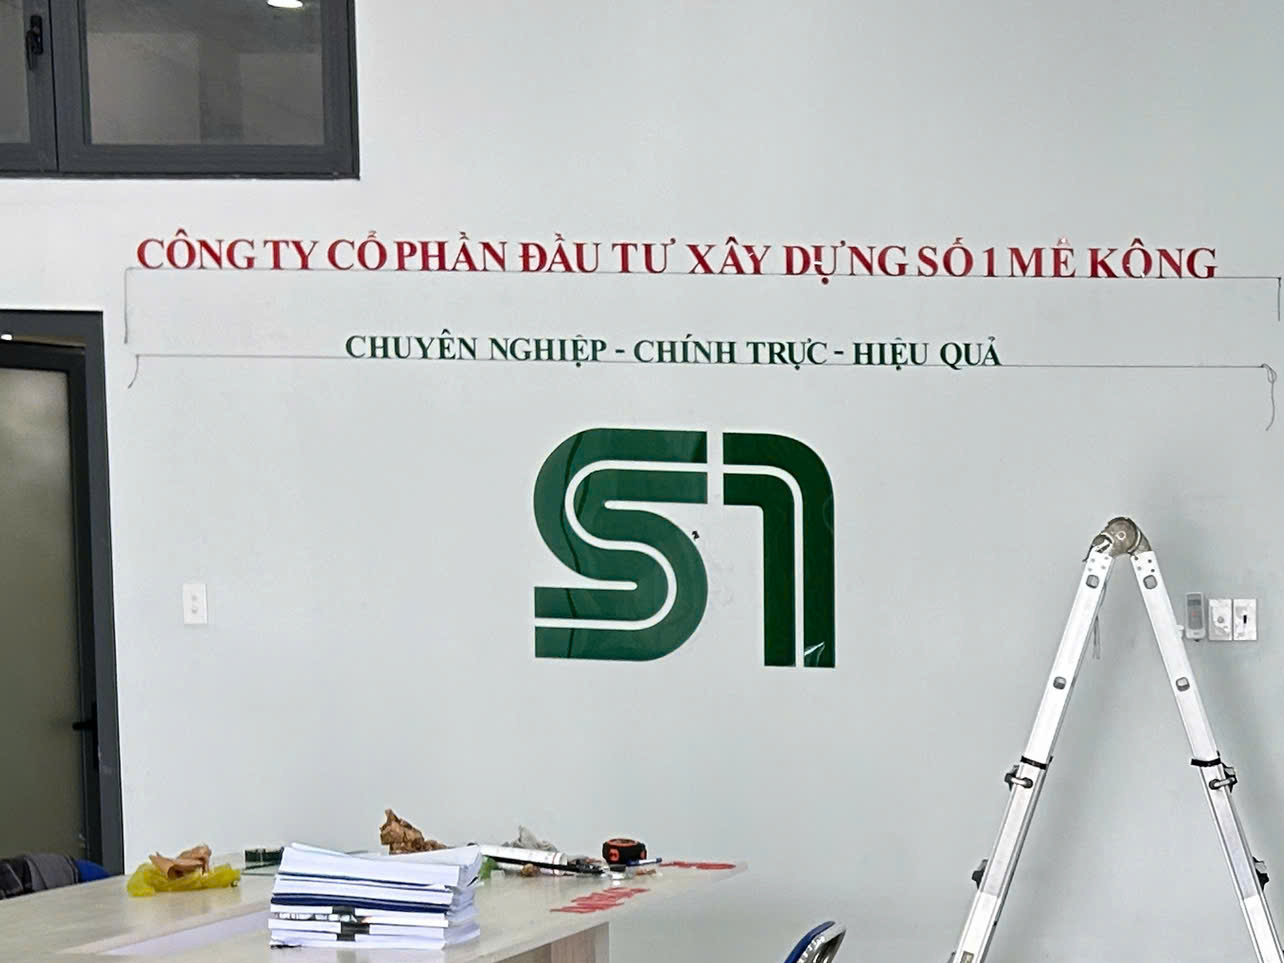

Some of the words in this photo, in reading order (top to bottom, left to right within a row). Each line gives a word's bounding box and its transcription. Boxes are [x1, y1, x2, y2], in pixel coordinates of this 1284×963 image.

[137, 228, 256, 270] CÔNG
[263, 239, 318, 271] TY
[327, 230, 388, 271] CỔ
[394, 231, 507, 272] PHẦN
[518, 233, 601, 273] ĐẦU
[611, 238, 677, 274] TƯ
[686, 236, 771, 275] XÂY
[782, 240, 909, 285] DỰNG
[918, 236, 974, 277] SỐ
[983, 247, 998, 277] 1
[1088, 237, 1217, 279] KÔNG
[345, 328, 477, 360] CHUYÊN
[489, 334, 607, 368] NGHIỆP
[633, 333, 737, 364] CHÍNH
[746, 337, 828, 371] TRỰC
[853, 337, 928, 371] HIỆU
[939, 335, 1002, 370] QUẢ
